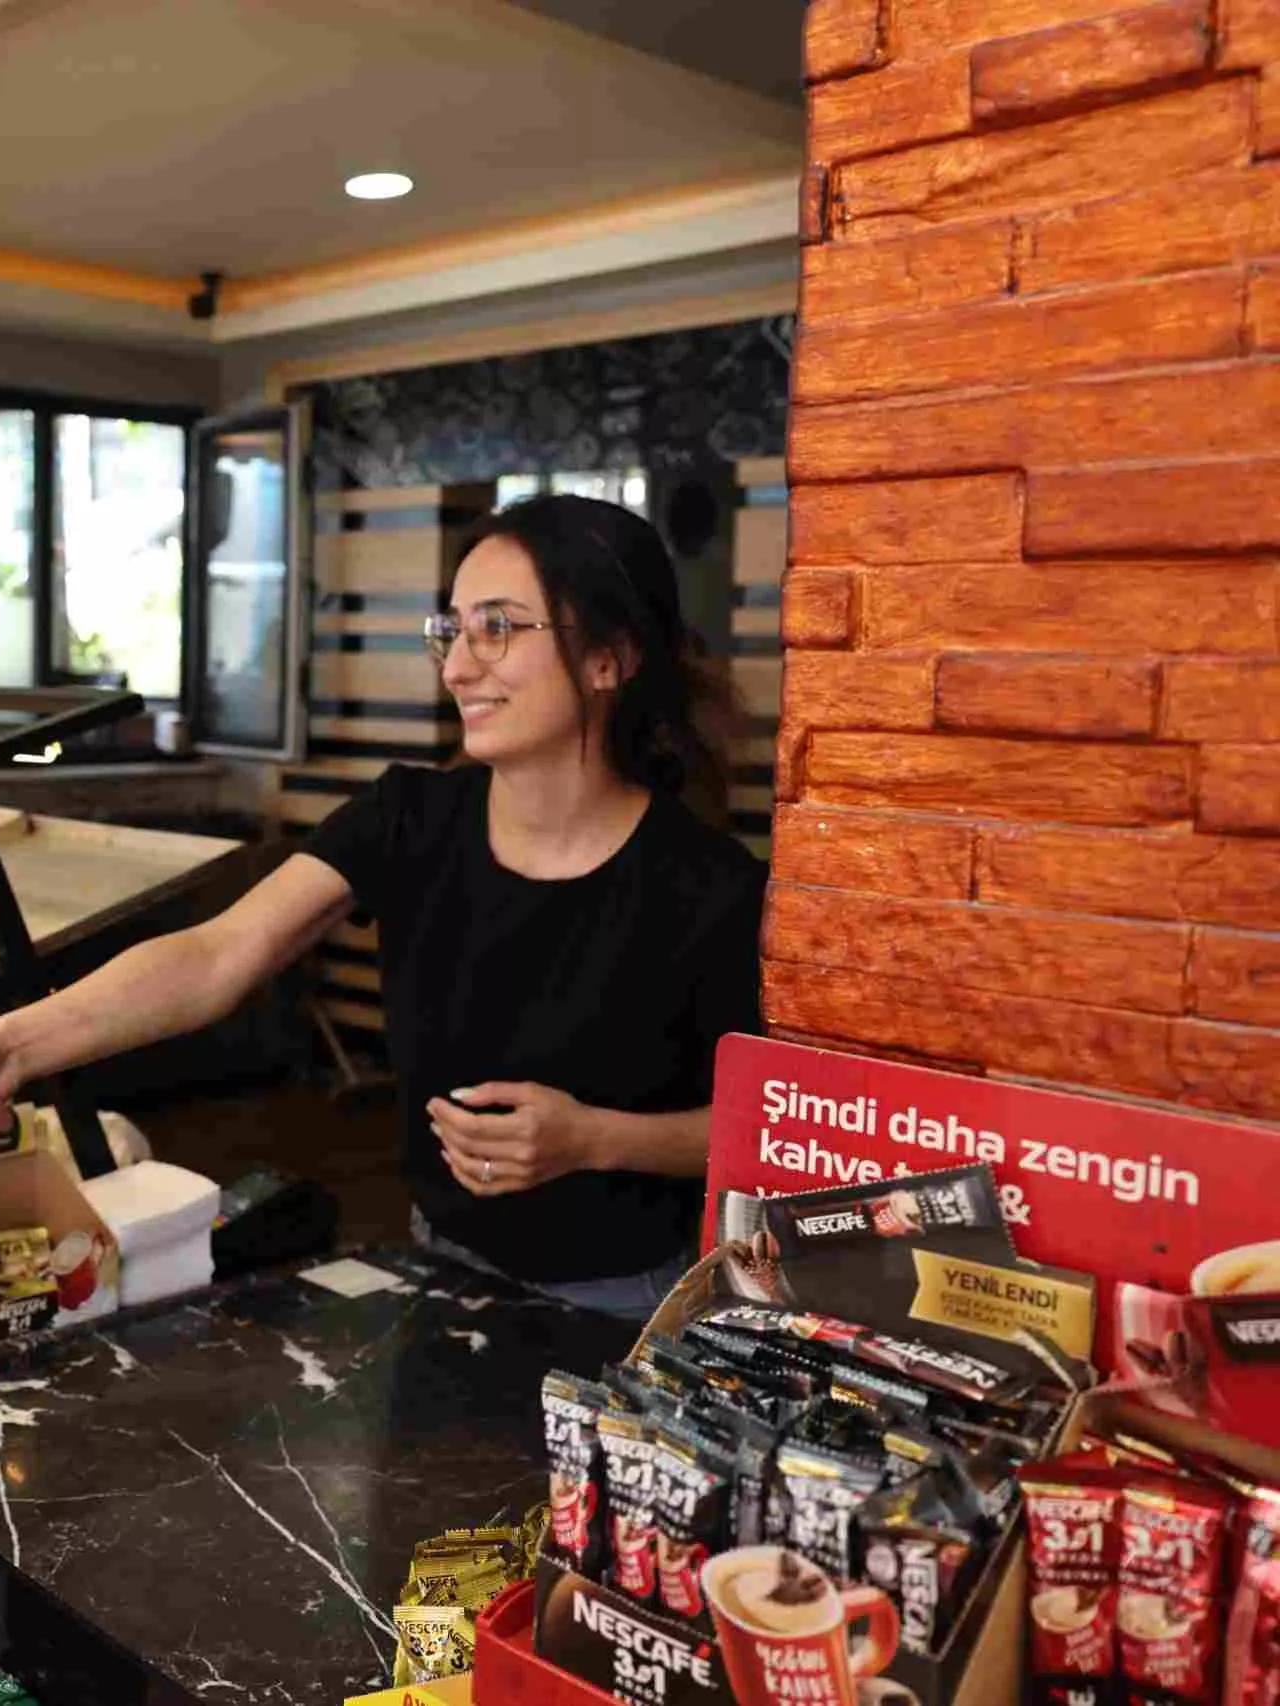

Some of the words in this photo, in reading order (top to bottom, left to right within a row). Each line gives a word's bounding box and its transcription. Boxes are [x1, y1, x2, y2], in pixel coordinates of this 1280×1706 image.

[759, 1127, 882, 1184] kahve
[762, 1079, 877, 1136] Şimdi
[888, 1107, 1005, 1164] daha
[1019, 1138, 1200, 1206] zengin
[999, 1183, 1032, 1226] &
